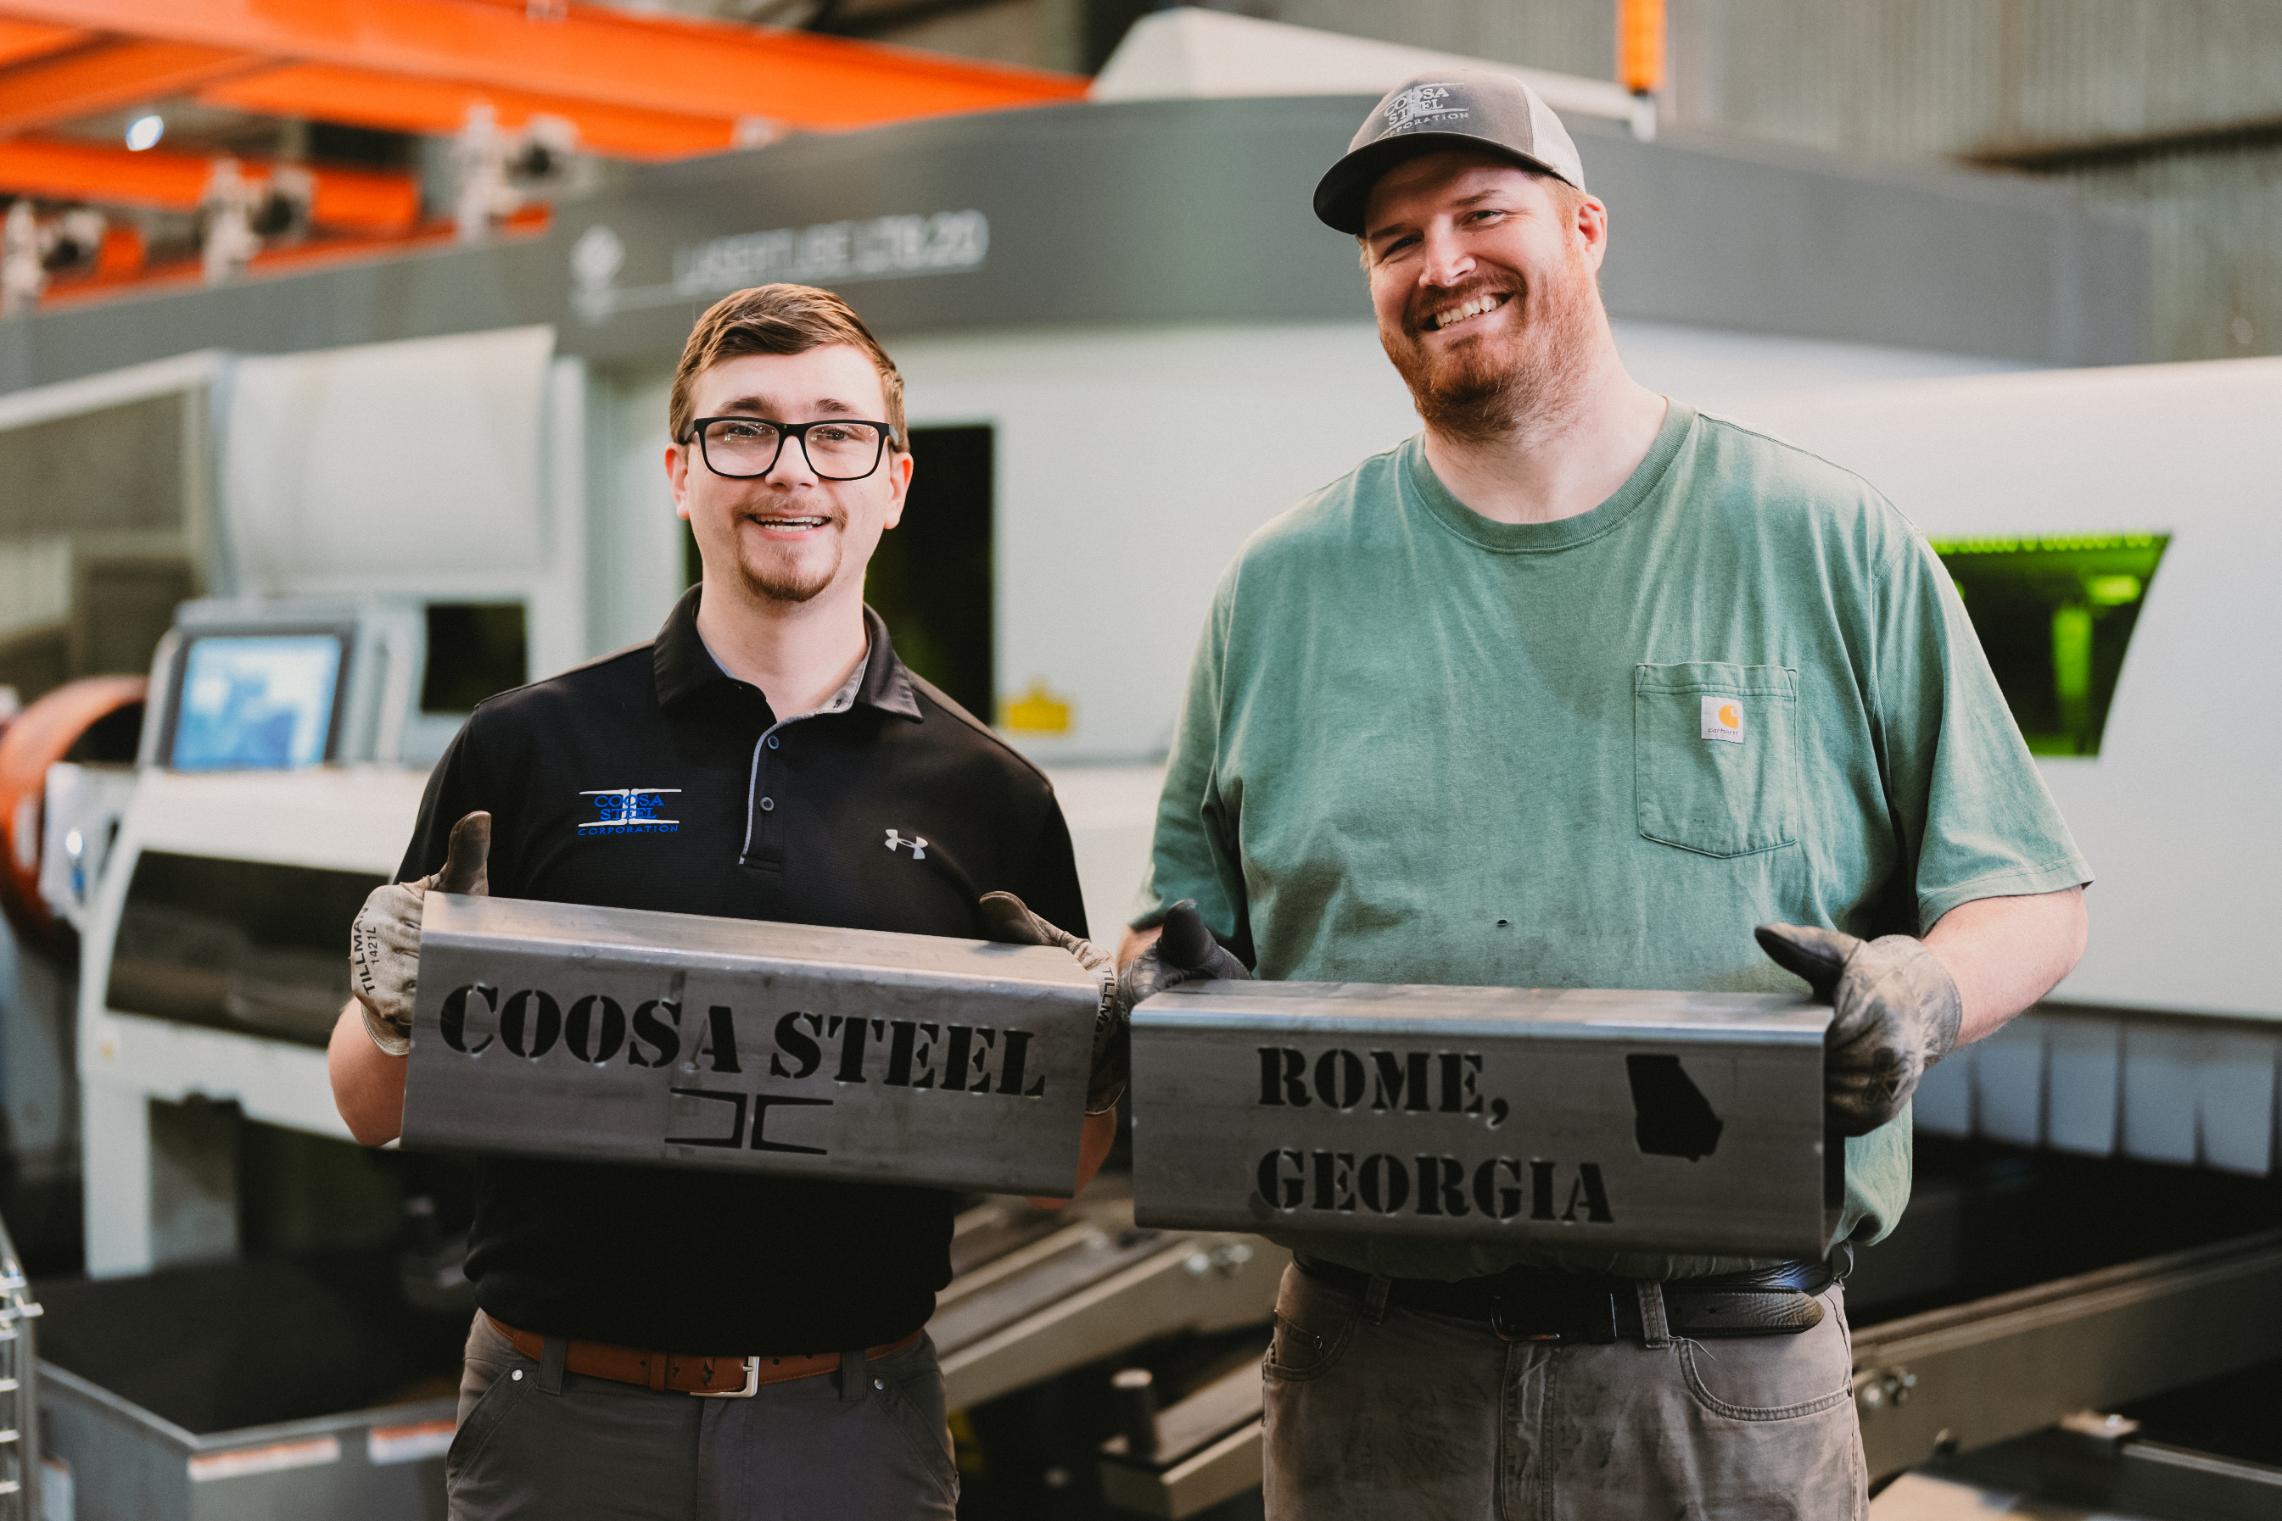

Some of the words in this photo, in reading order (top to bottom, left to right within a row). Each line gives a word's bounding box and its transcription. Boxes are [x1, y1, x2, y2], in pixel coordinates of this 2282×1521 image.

[593, 793, 664, 808] COOSA
[600, 807, 657, 821] STEEL
[577, 824, 679, 836] CORPORATION
[366, 926, 379, 965] 1421L
[440, 984, 743, 1073] COOSA
[769, 1011, 1046, 1097] STEEL
[1257, 1045, 1510, 1127] ROME,
[1256, 1148, 1615, 1223] GEORGIA
